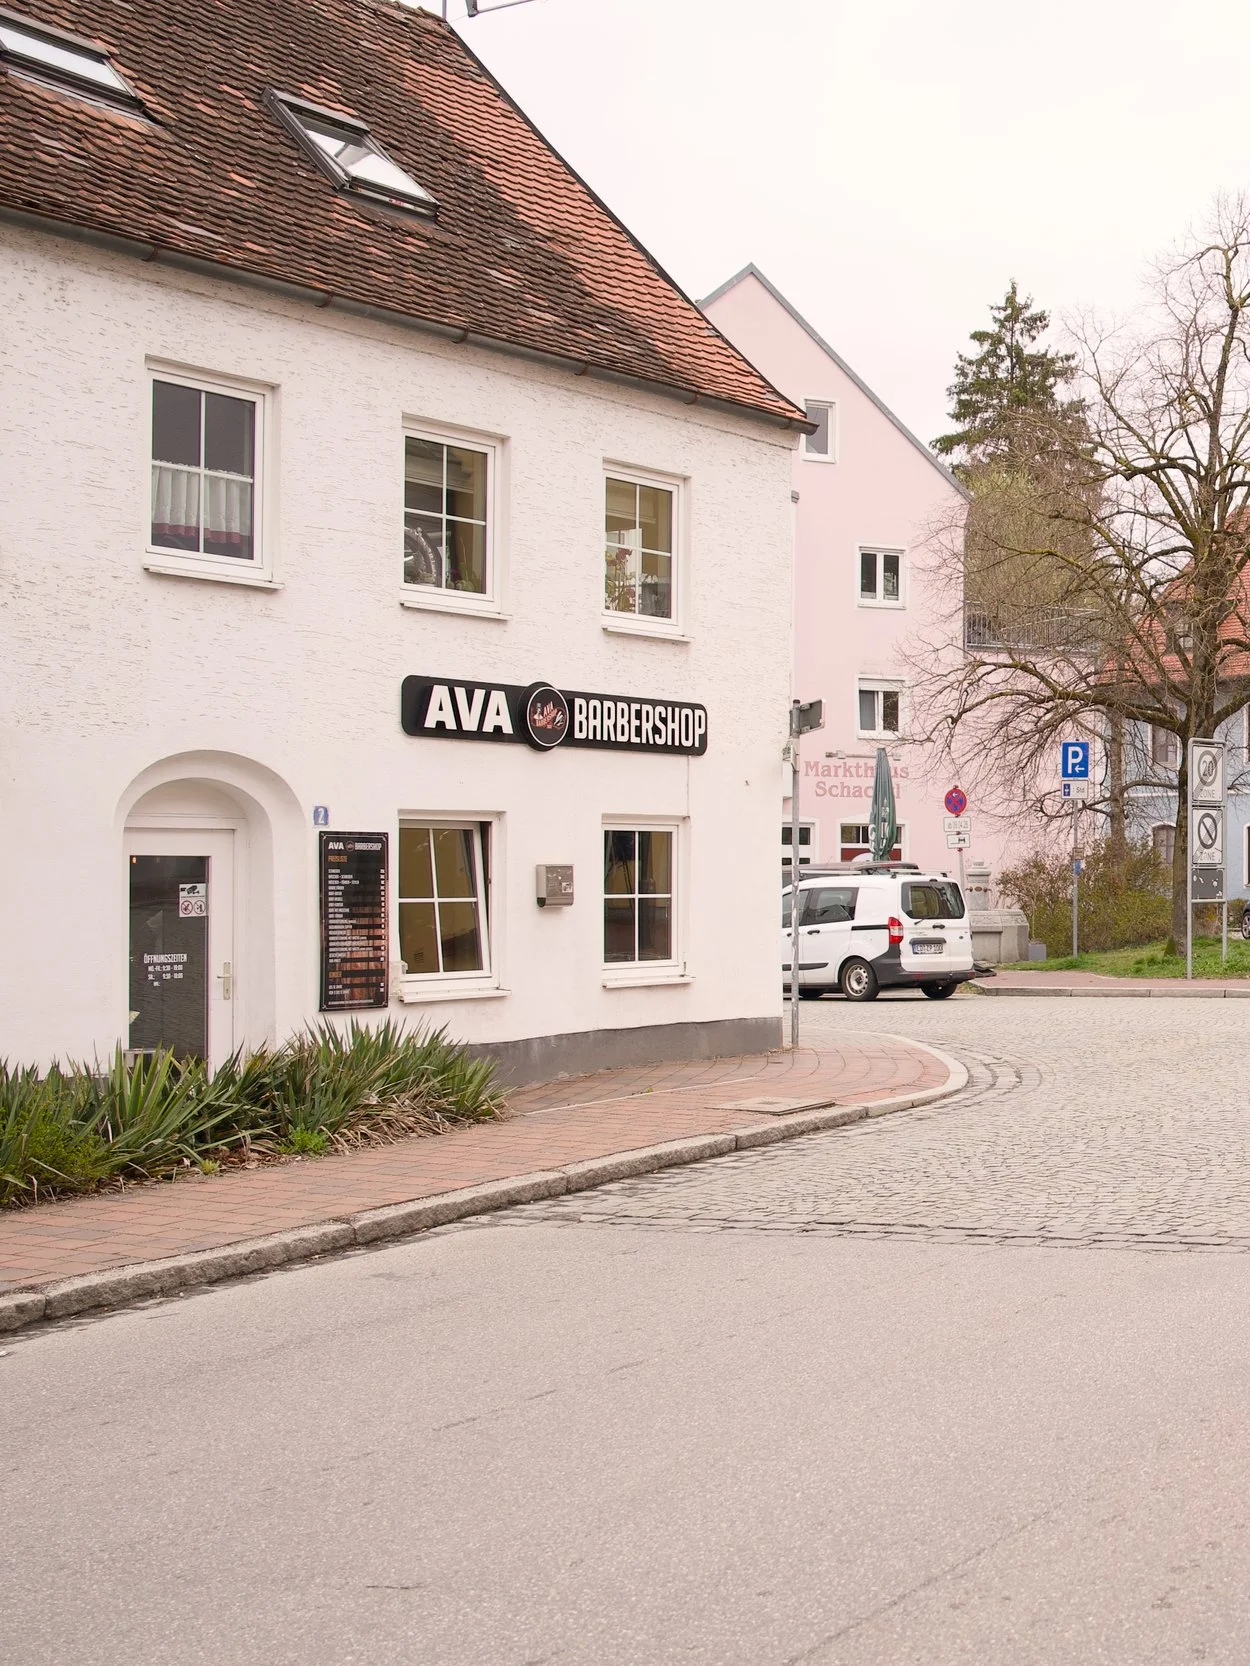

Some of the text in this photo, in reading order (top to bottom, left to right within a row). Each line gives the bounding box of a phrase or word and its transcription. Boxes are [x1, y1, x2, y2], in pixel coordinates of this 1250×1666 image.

[423, 684, 706, 748] AVA BARBERSHOP
[1067, 746, 1083, 774] P
[1202, 760, 1214, 777] 20
[804, 760, 910, 778] Markthus
[1199, 789, 1216, 799] ZONE
[317, 807, 325, 824] 2
[328, 842, 344, 850] AVA
[1199, 851, 1216, 861] ZONE
[143, 953, 188, 963] ÖFFNUNGSZEITEN
